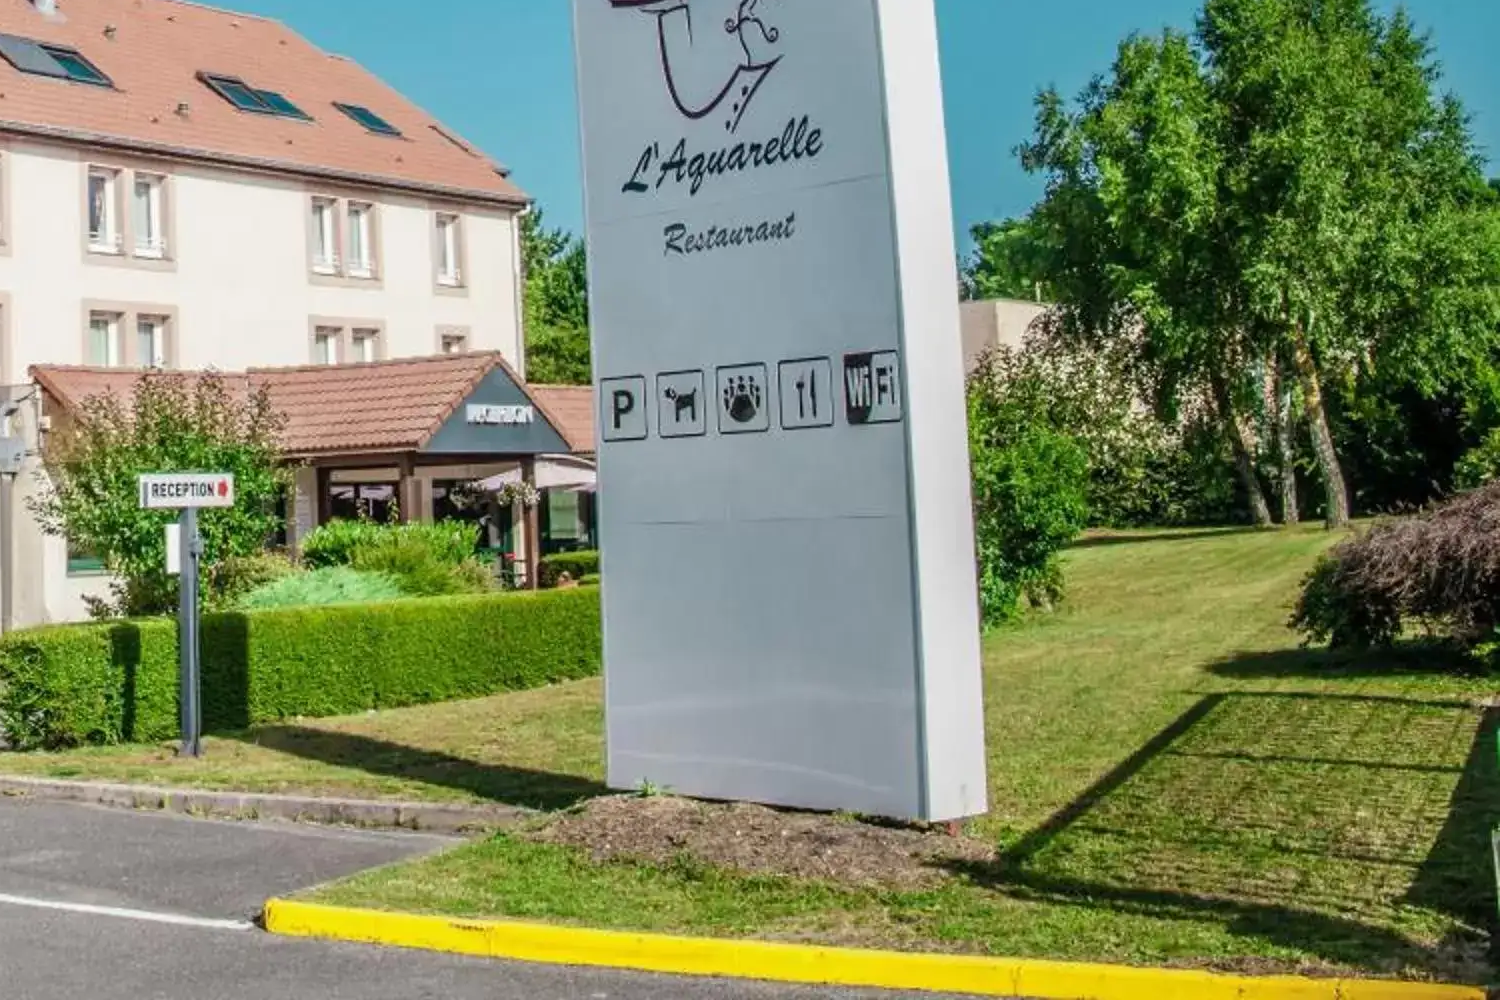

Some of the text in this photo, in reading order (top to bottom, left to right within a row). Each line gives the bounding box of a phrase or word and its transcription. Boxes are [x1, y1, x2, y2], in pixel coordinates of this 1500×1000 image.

[621, 114, 823, 196] L'Aquarelle
[663, 212, 796, 256] Restaurant
[612, 390, 634, 428] P
[151, 482, 215, 497] RECEPTION
